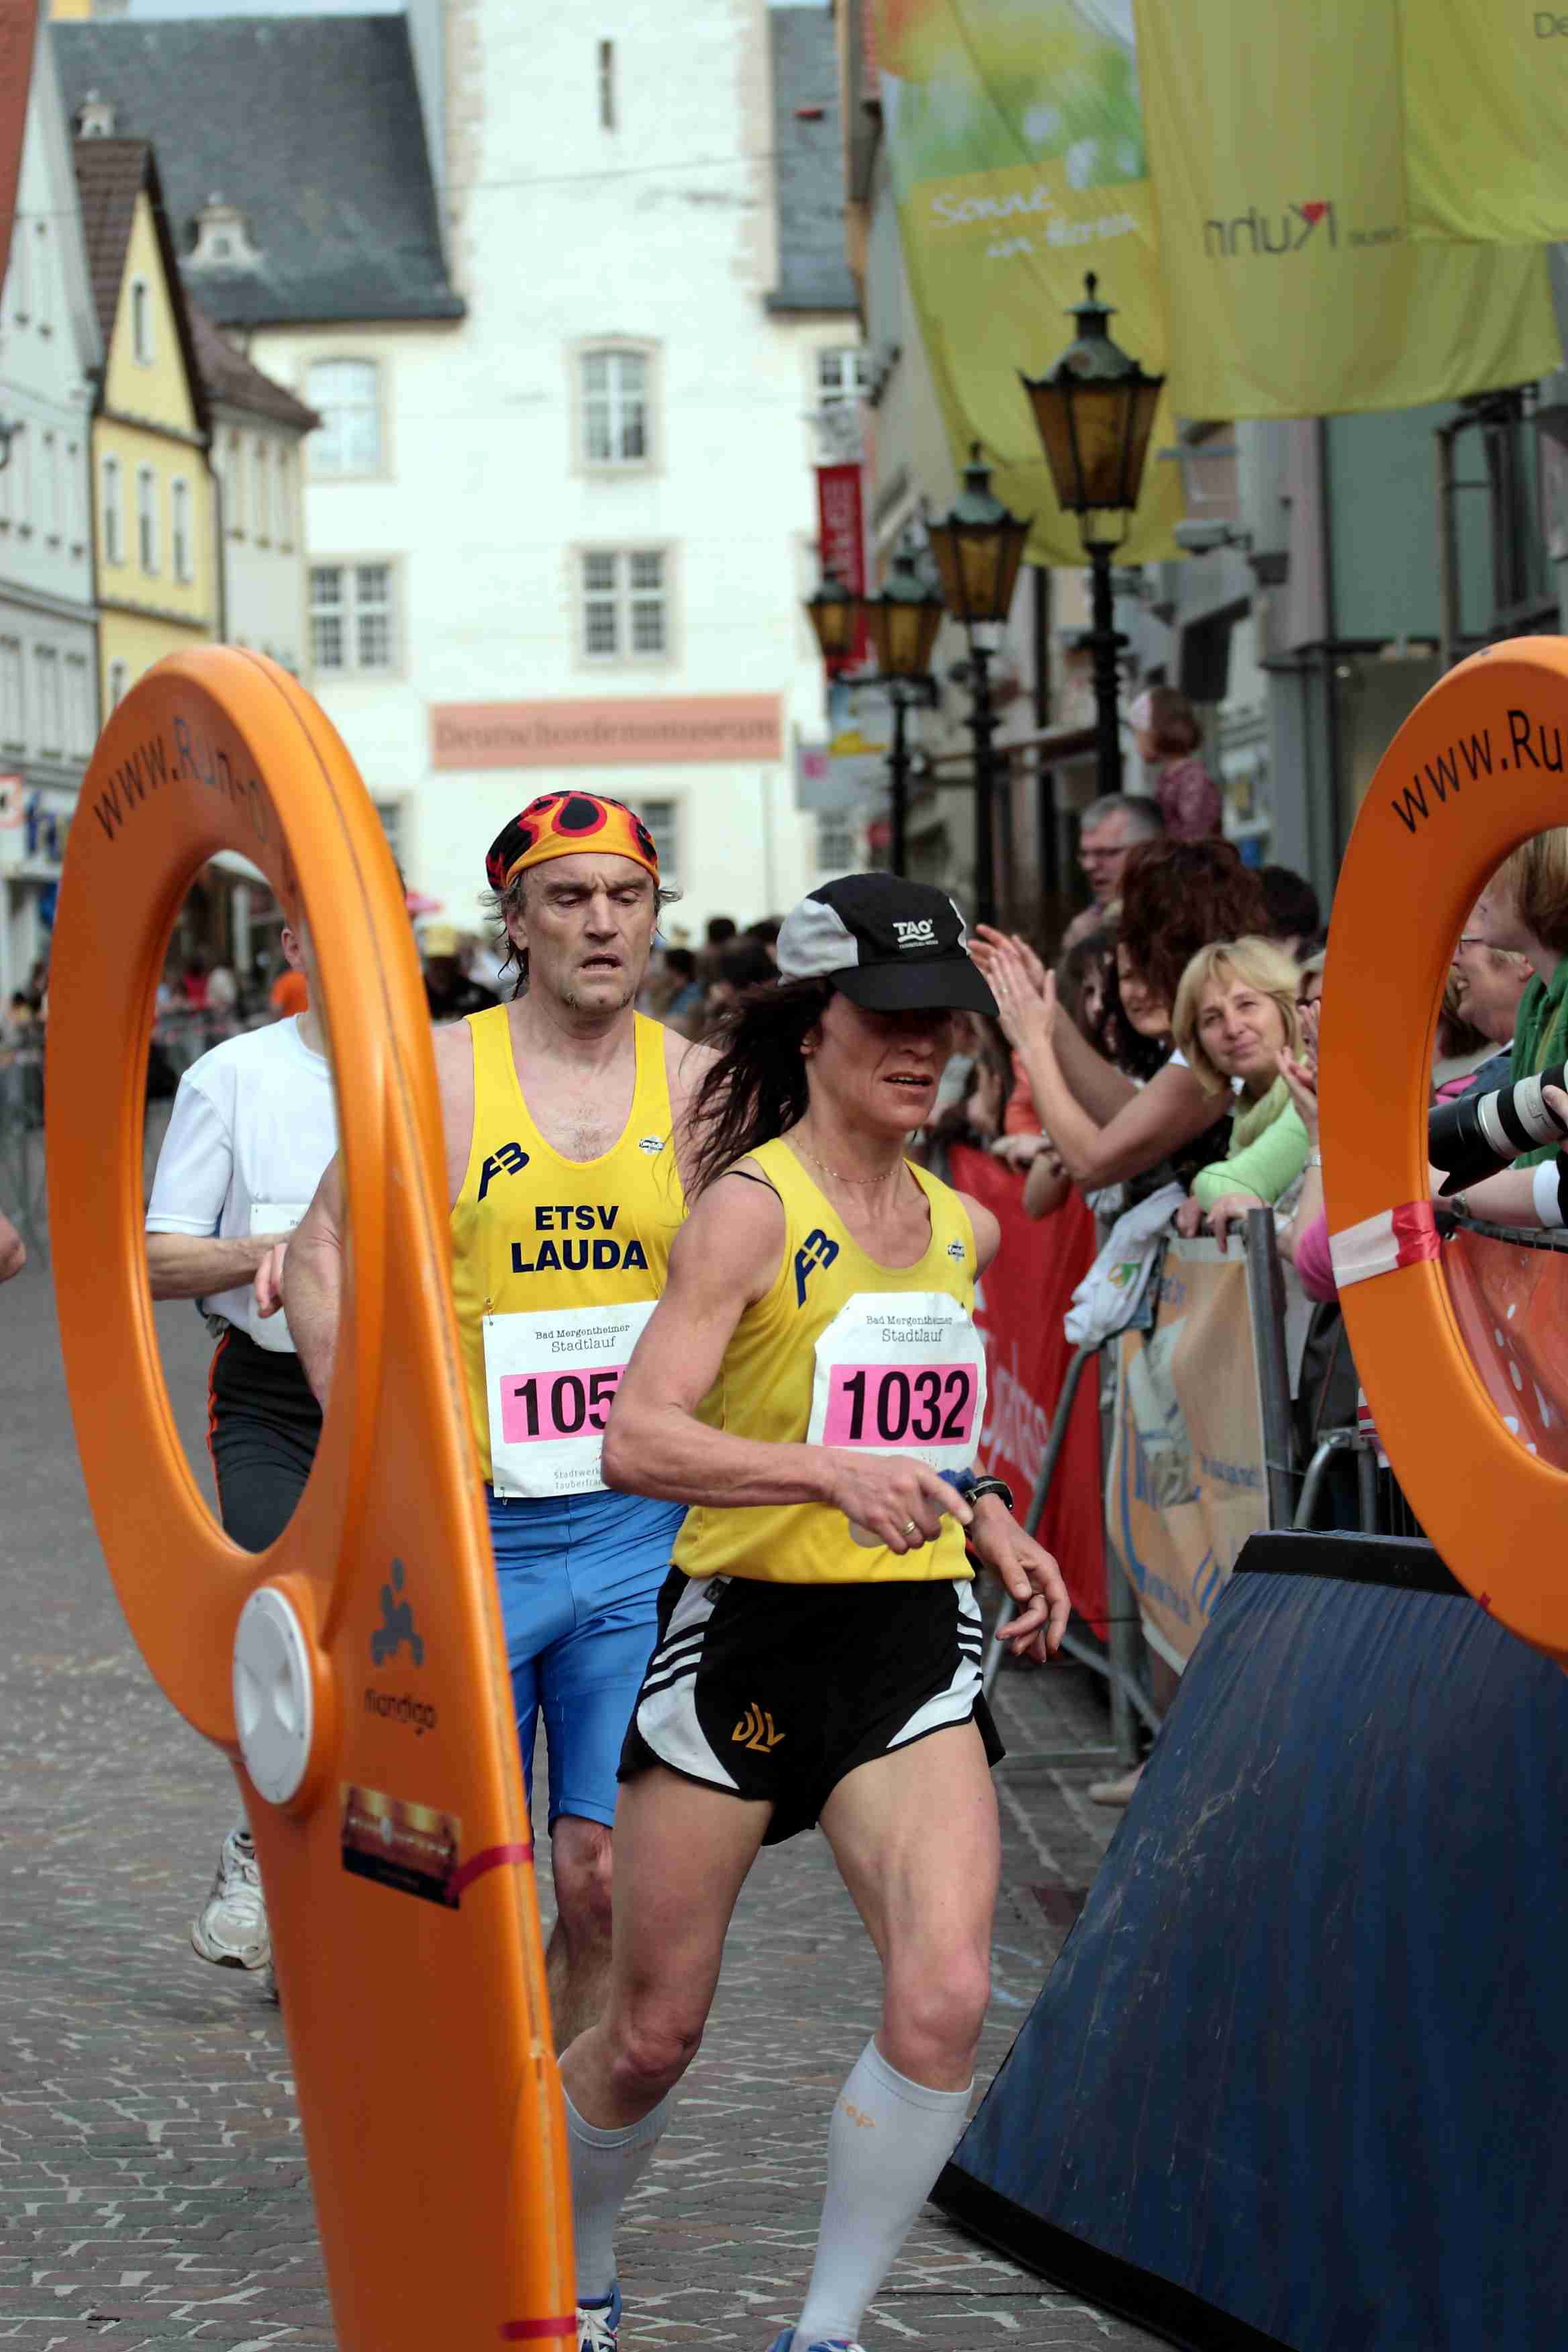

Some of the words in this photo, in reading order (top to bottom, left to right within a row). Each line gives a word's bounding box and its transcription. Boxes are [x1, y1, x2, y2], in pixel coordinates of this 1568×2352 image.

[893, 920, 932, 936] TAO
[534, 1206, 619, 1231] ETSV
[510, 1239, 648, 1273] LAUDA
[866, 1316, 885, 1325] Bad
[535, 1330, 554, 1340] Bad
[556, 1324, 630, 1338] Mergentheimer
[881, 1328, 944, 1342] Stadtlauf
[552, 1336, 616, 1353] Stadtlauf
[514, 1371, 624, 1436] 105
[843, 1370, 969, 1441] 1032
[554, 1467, 602, 1479] Stadtwerk
[554, 1478, 602, 1489] Tauberfran
